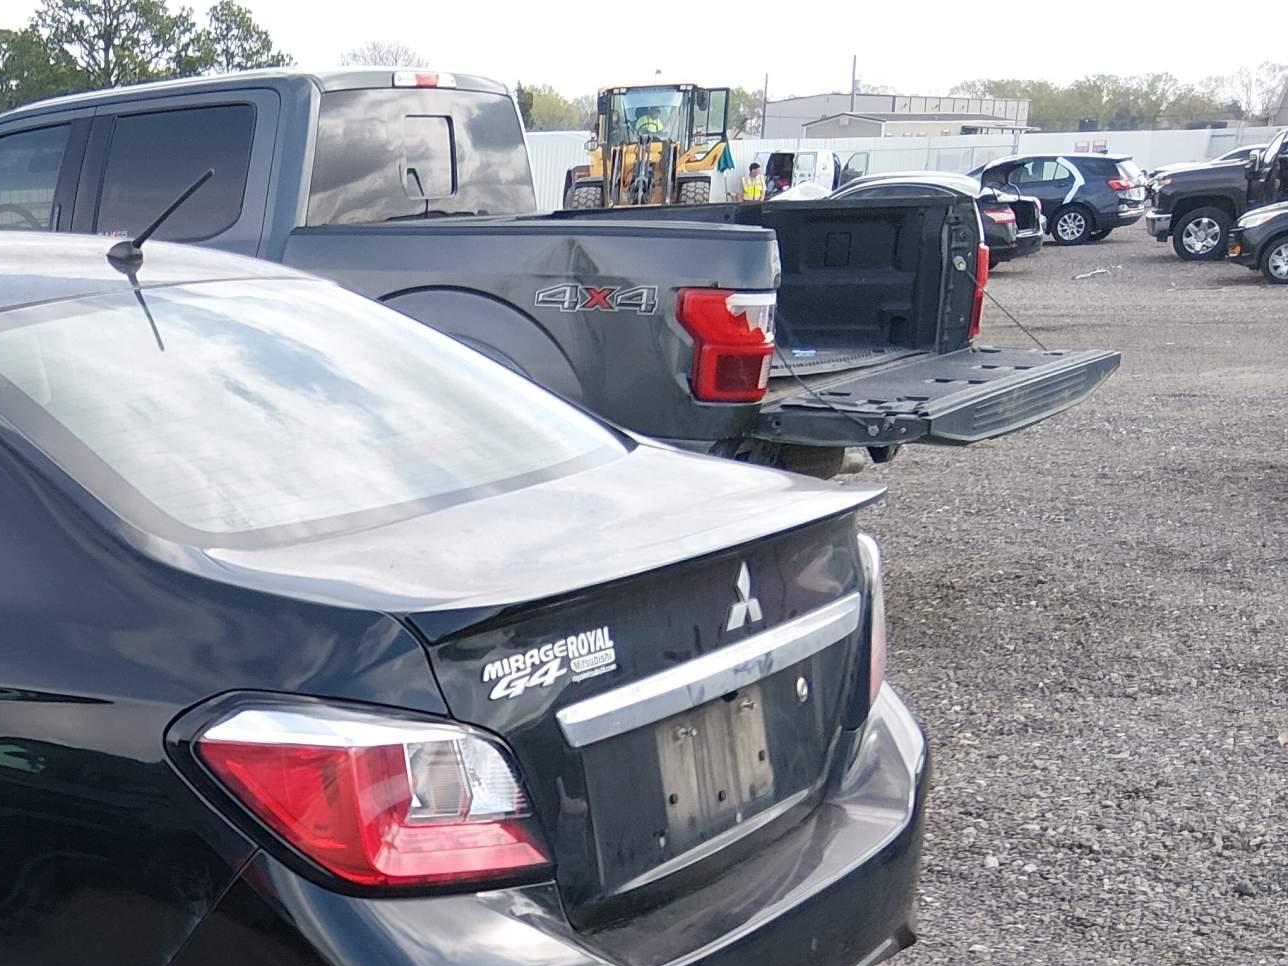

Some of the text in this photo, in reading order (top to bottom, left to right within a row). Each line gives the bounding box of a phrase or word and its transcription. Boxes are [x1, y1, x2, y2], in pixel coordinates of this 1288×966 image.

[482, 638, 568, 682] MIRAGE
[567, 625, 614, 659] ROYAL
[489, 658, 568, 700] G4
